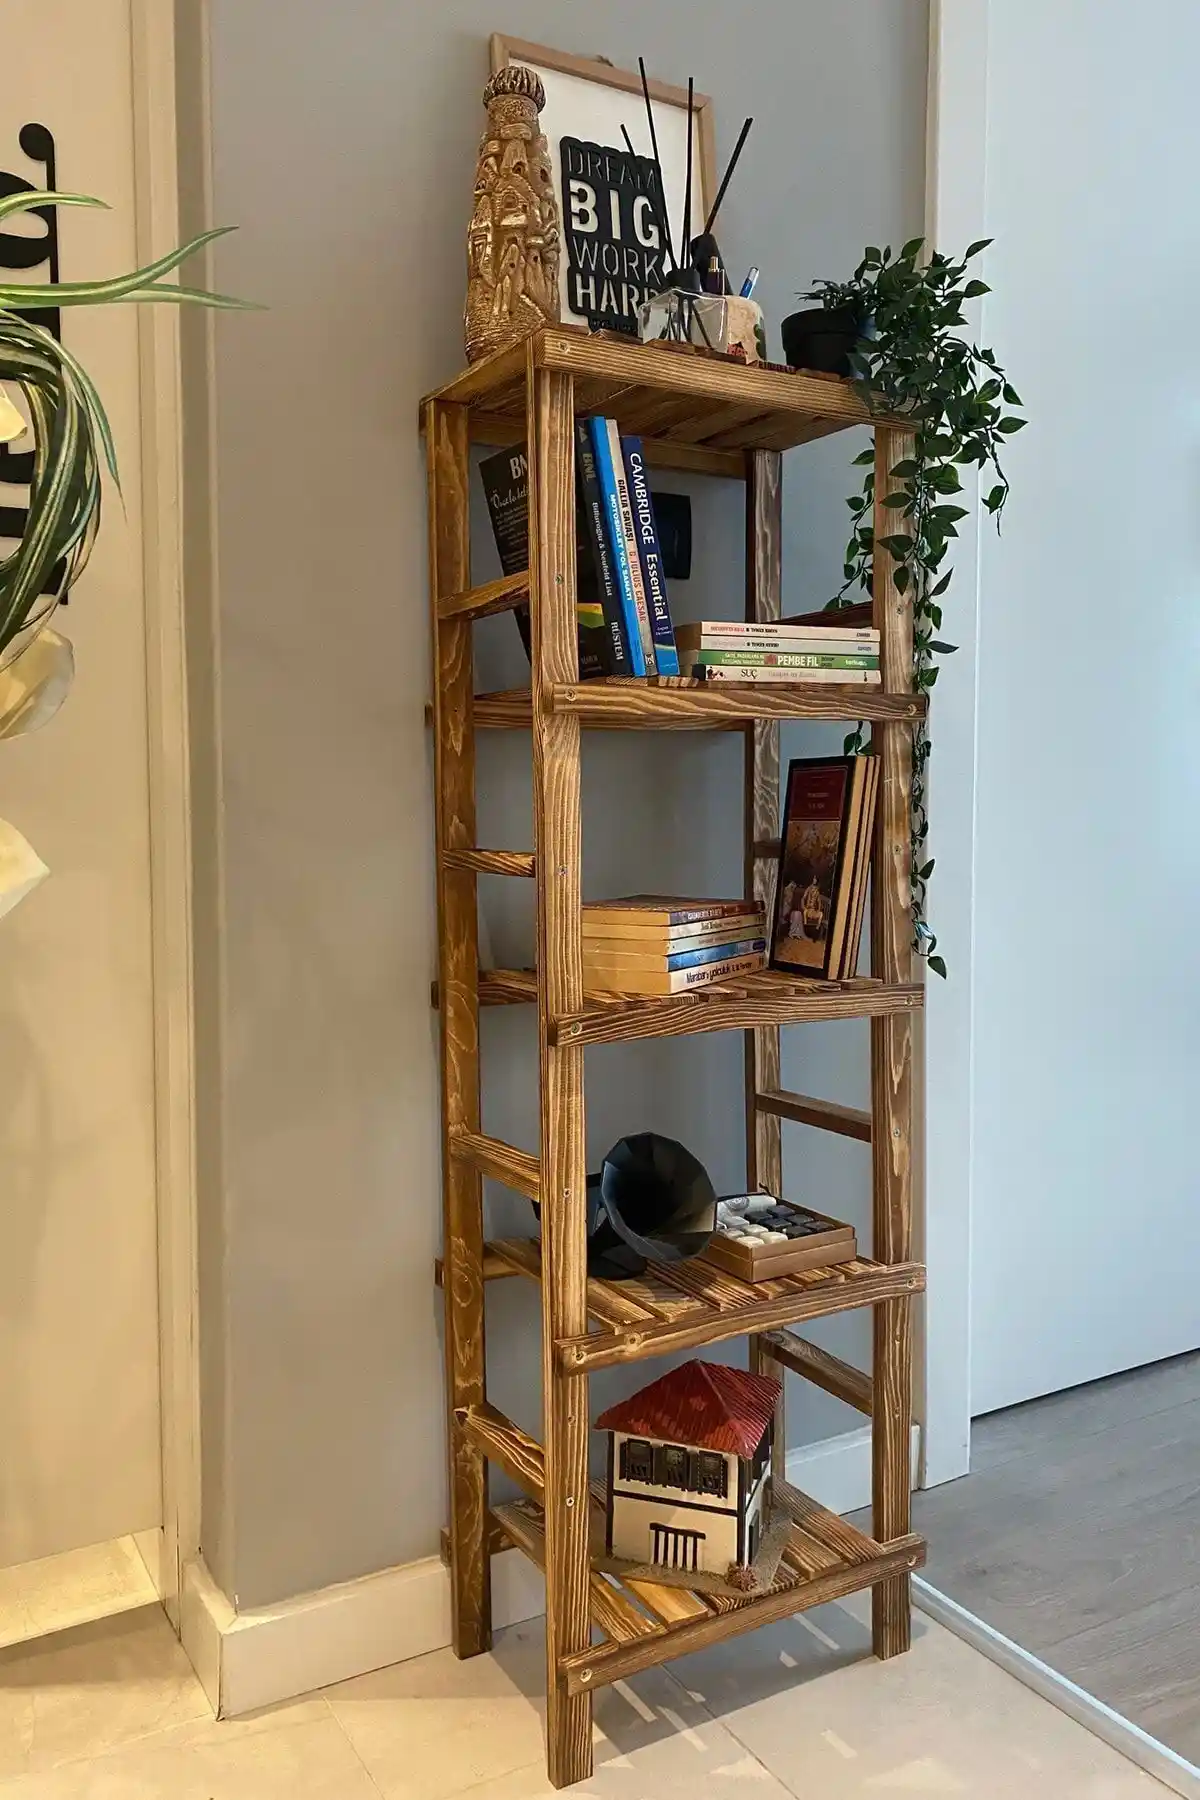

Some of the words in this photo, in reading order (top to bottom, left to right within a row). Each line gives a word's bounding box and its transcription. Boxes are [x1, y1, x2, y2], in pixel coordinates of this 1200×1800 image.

[568, 146, 657, 193] DREAM
[569, 178, 660, 249] BIG
[572, 235, 662, 286] WORK
[509, 453, 528, 480] BN
[630, 453, 655, 545] CAMBRIDGE
[646, 553, 668, 621] Essential
[777, 655, 806, 667] PEMBE
